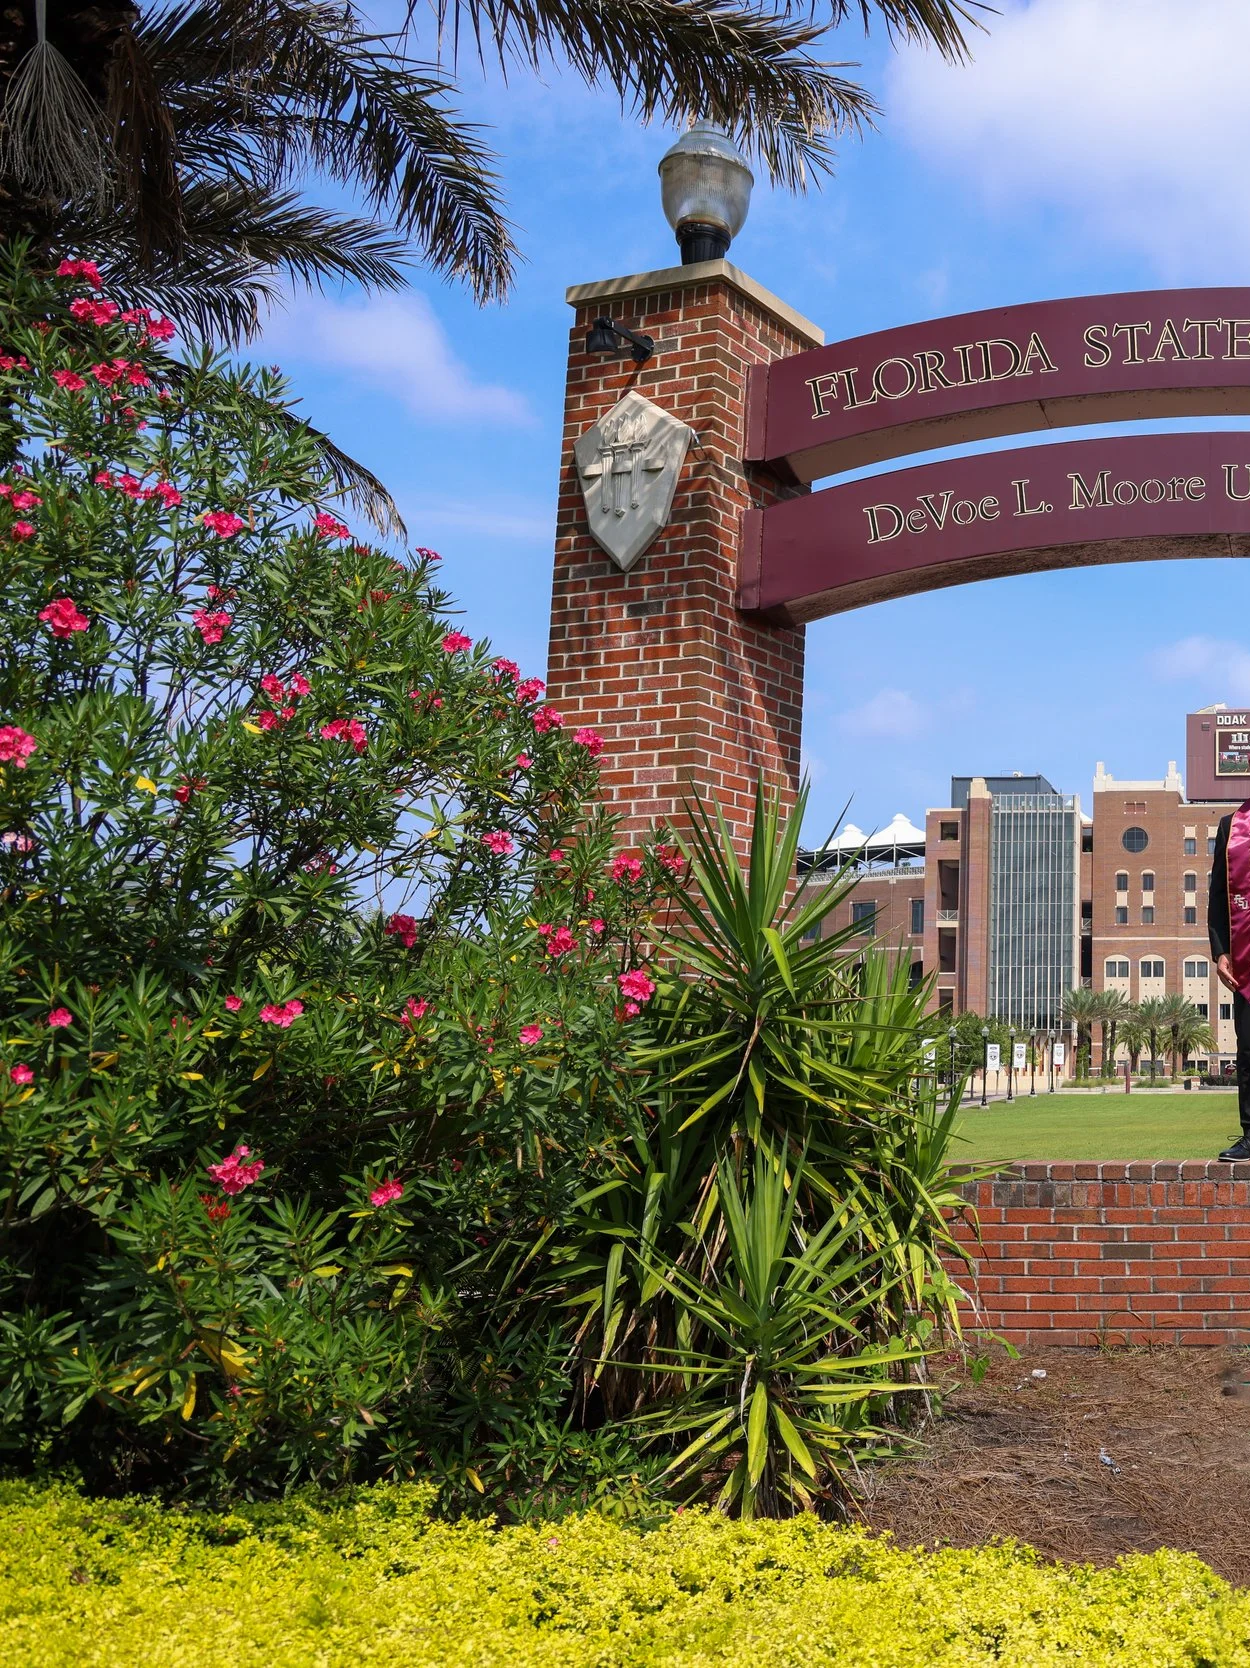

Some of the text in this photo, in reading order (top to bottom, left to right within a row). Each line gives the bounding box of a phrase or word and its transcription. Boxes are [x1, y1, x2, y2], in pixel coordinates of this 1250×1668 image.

[805, 332, 1058, 419] FLORIDA
[862, 491, 1000, 544] DeVoe
[1011, 479, 1054, 517] L.
[1067, 470, 1206, 510] Moore
[1216, 714, 1247, 725] DOAK
[1233, 894, 1249, 910] FSU
